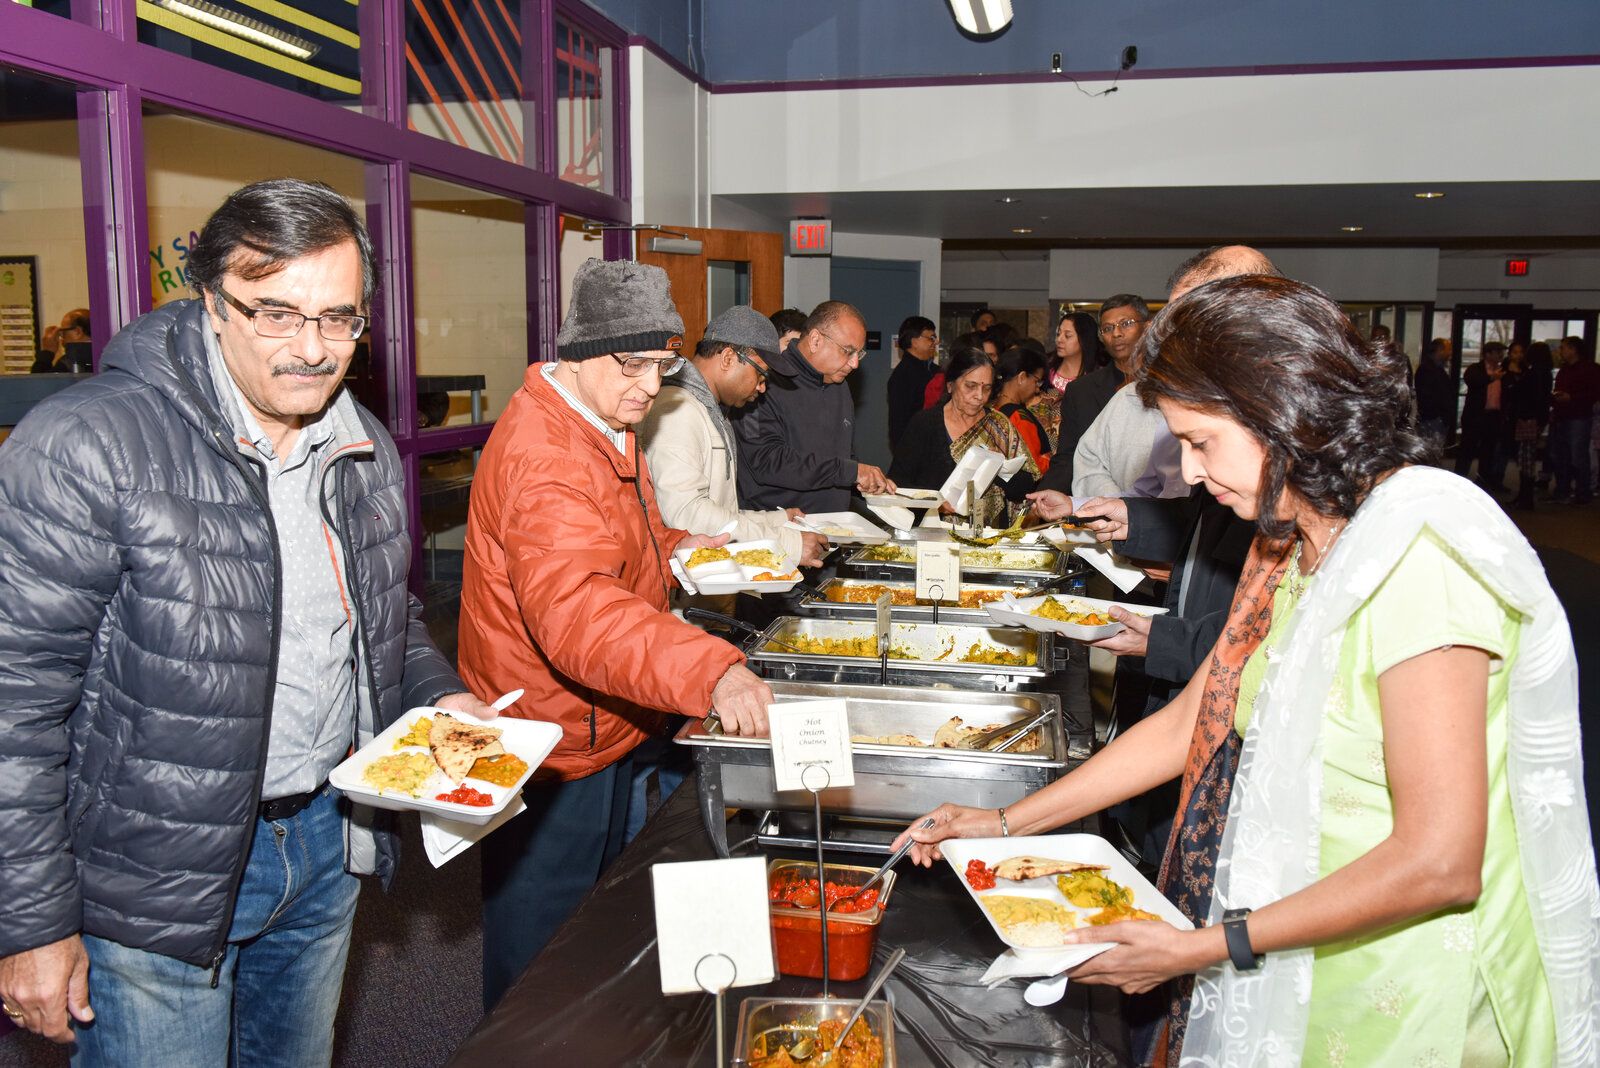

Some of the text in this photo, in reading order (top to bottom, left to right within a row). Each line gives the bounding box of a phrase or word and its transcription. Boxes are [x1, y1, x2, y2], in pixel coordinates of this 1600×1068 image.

[797, 225, 826, 249] EXIT
[1510, 261, 1527, 275] EXIT
[805, 718, 821, 726] Hot
